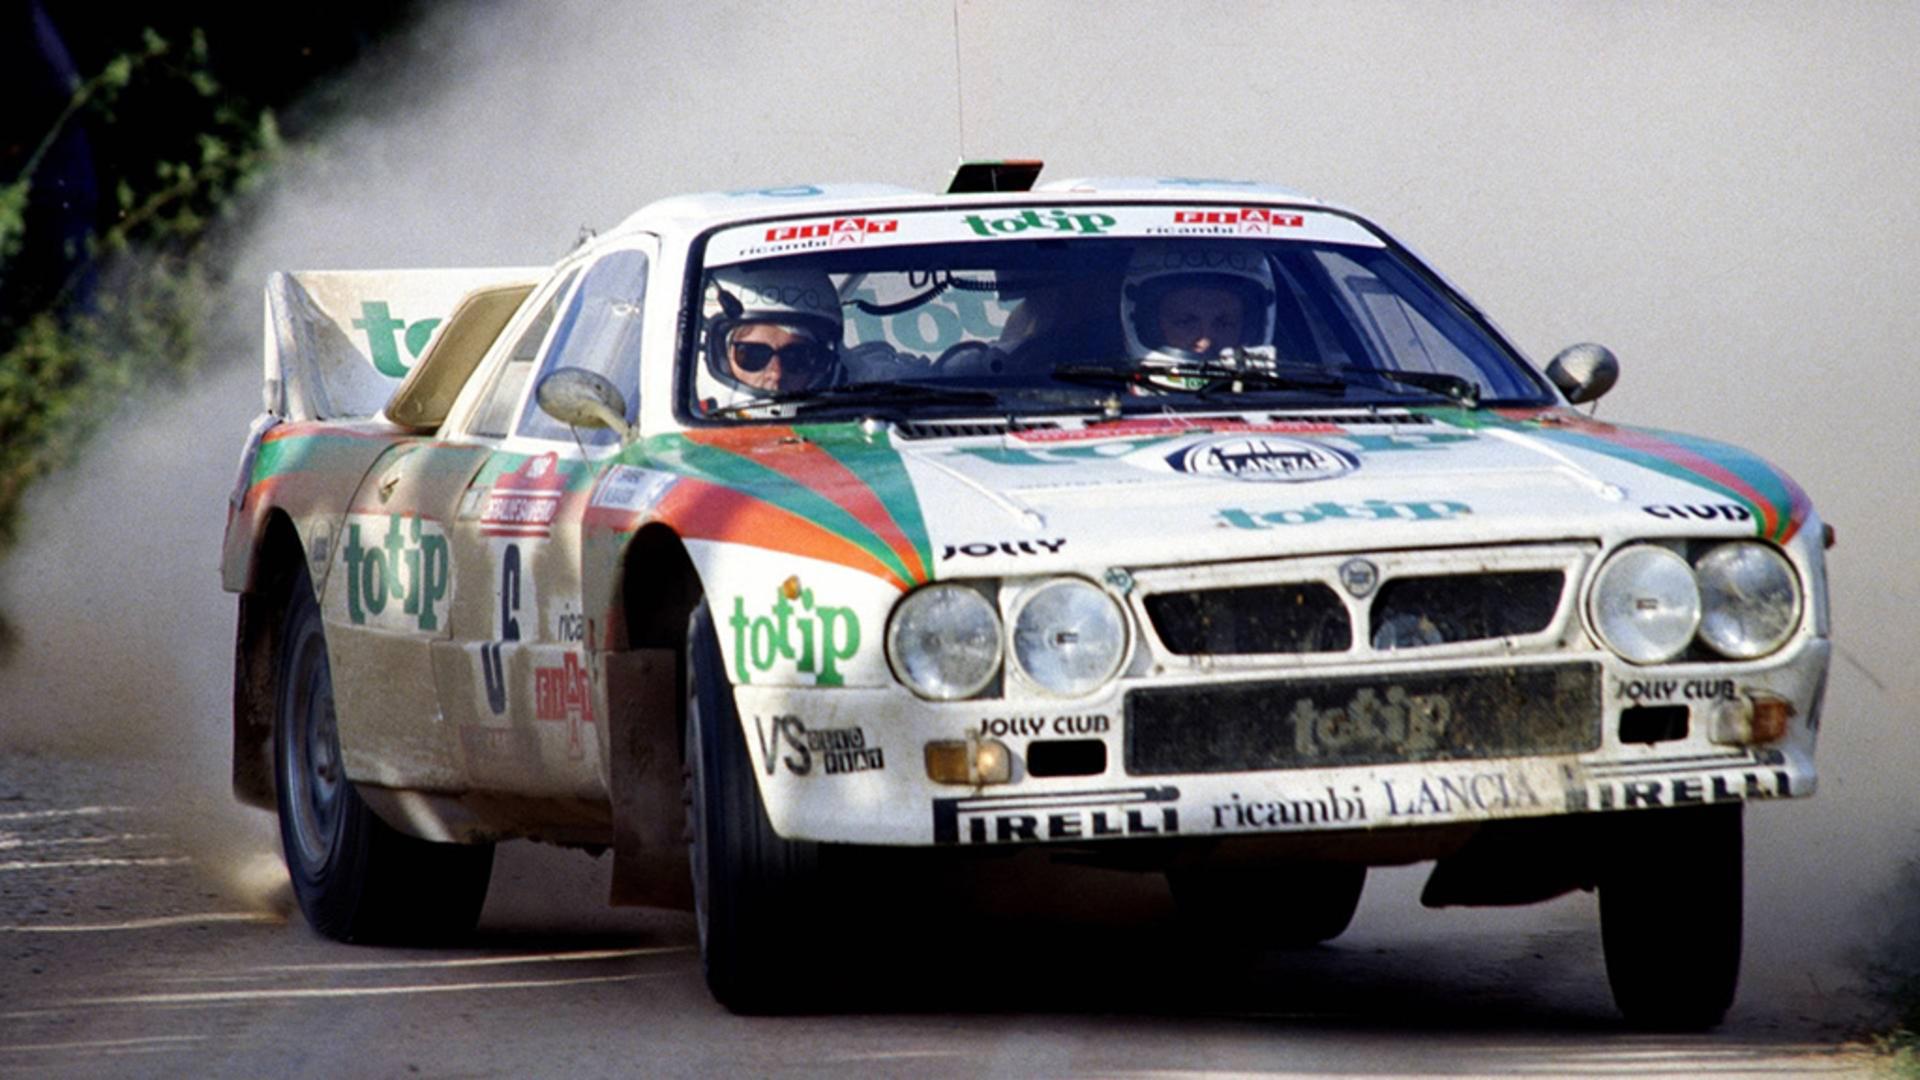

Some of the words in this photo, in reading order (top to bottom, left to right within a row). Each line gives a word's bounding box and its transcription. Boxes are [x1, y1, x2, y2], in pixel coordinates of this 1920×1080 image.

[765, 217, 898, 243] FIAT
[961, 209, 1117, 237] totip
[1145, 225, 1235, 235] ricambi
[1174, 208, 1304, 228] FIAT
[738, 239, 828, 256] ricambi
[1227, 456, 1329, 474] LANCIA
[1212, 500, 1474, 530] totip
[1642, 504, 1751, 521] CLUB
[942, 538, 1067, 561] JOLLY
[343, 512, 449, 631] totip
[729, 587, 861, 687] totip
[535, 652, 594, 721] FIAT
[1616, 680, 1677, 700] JOLLY
[1683, 680, 1736, 700] CLUB
[980, 717, 1046, 736] JOLLY
[1052, 715, 1110, 733] CLUB
[1286, 685, 1451, 756] totip
[754, 714, 812, 776] VS
[824, 747, 885, 775] FIAT
[1561, 750, 1794, 813] PIRELLI
[1213, 784, 1368, 830] ricambi
[1382, 772, 1540, 817] LANCIA
[933, 786, 1181, 845] PIRELLI
